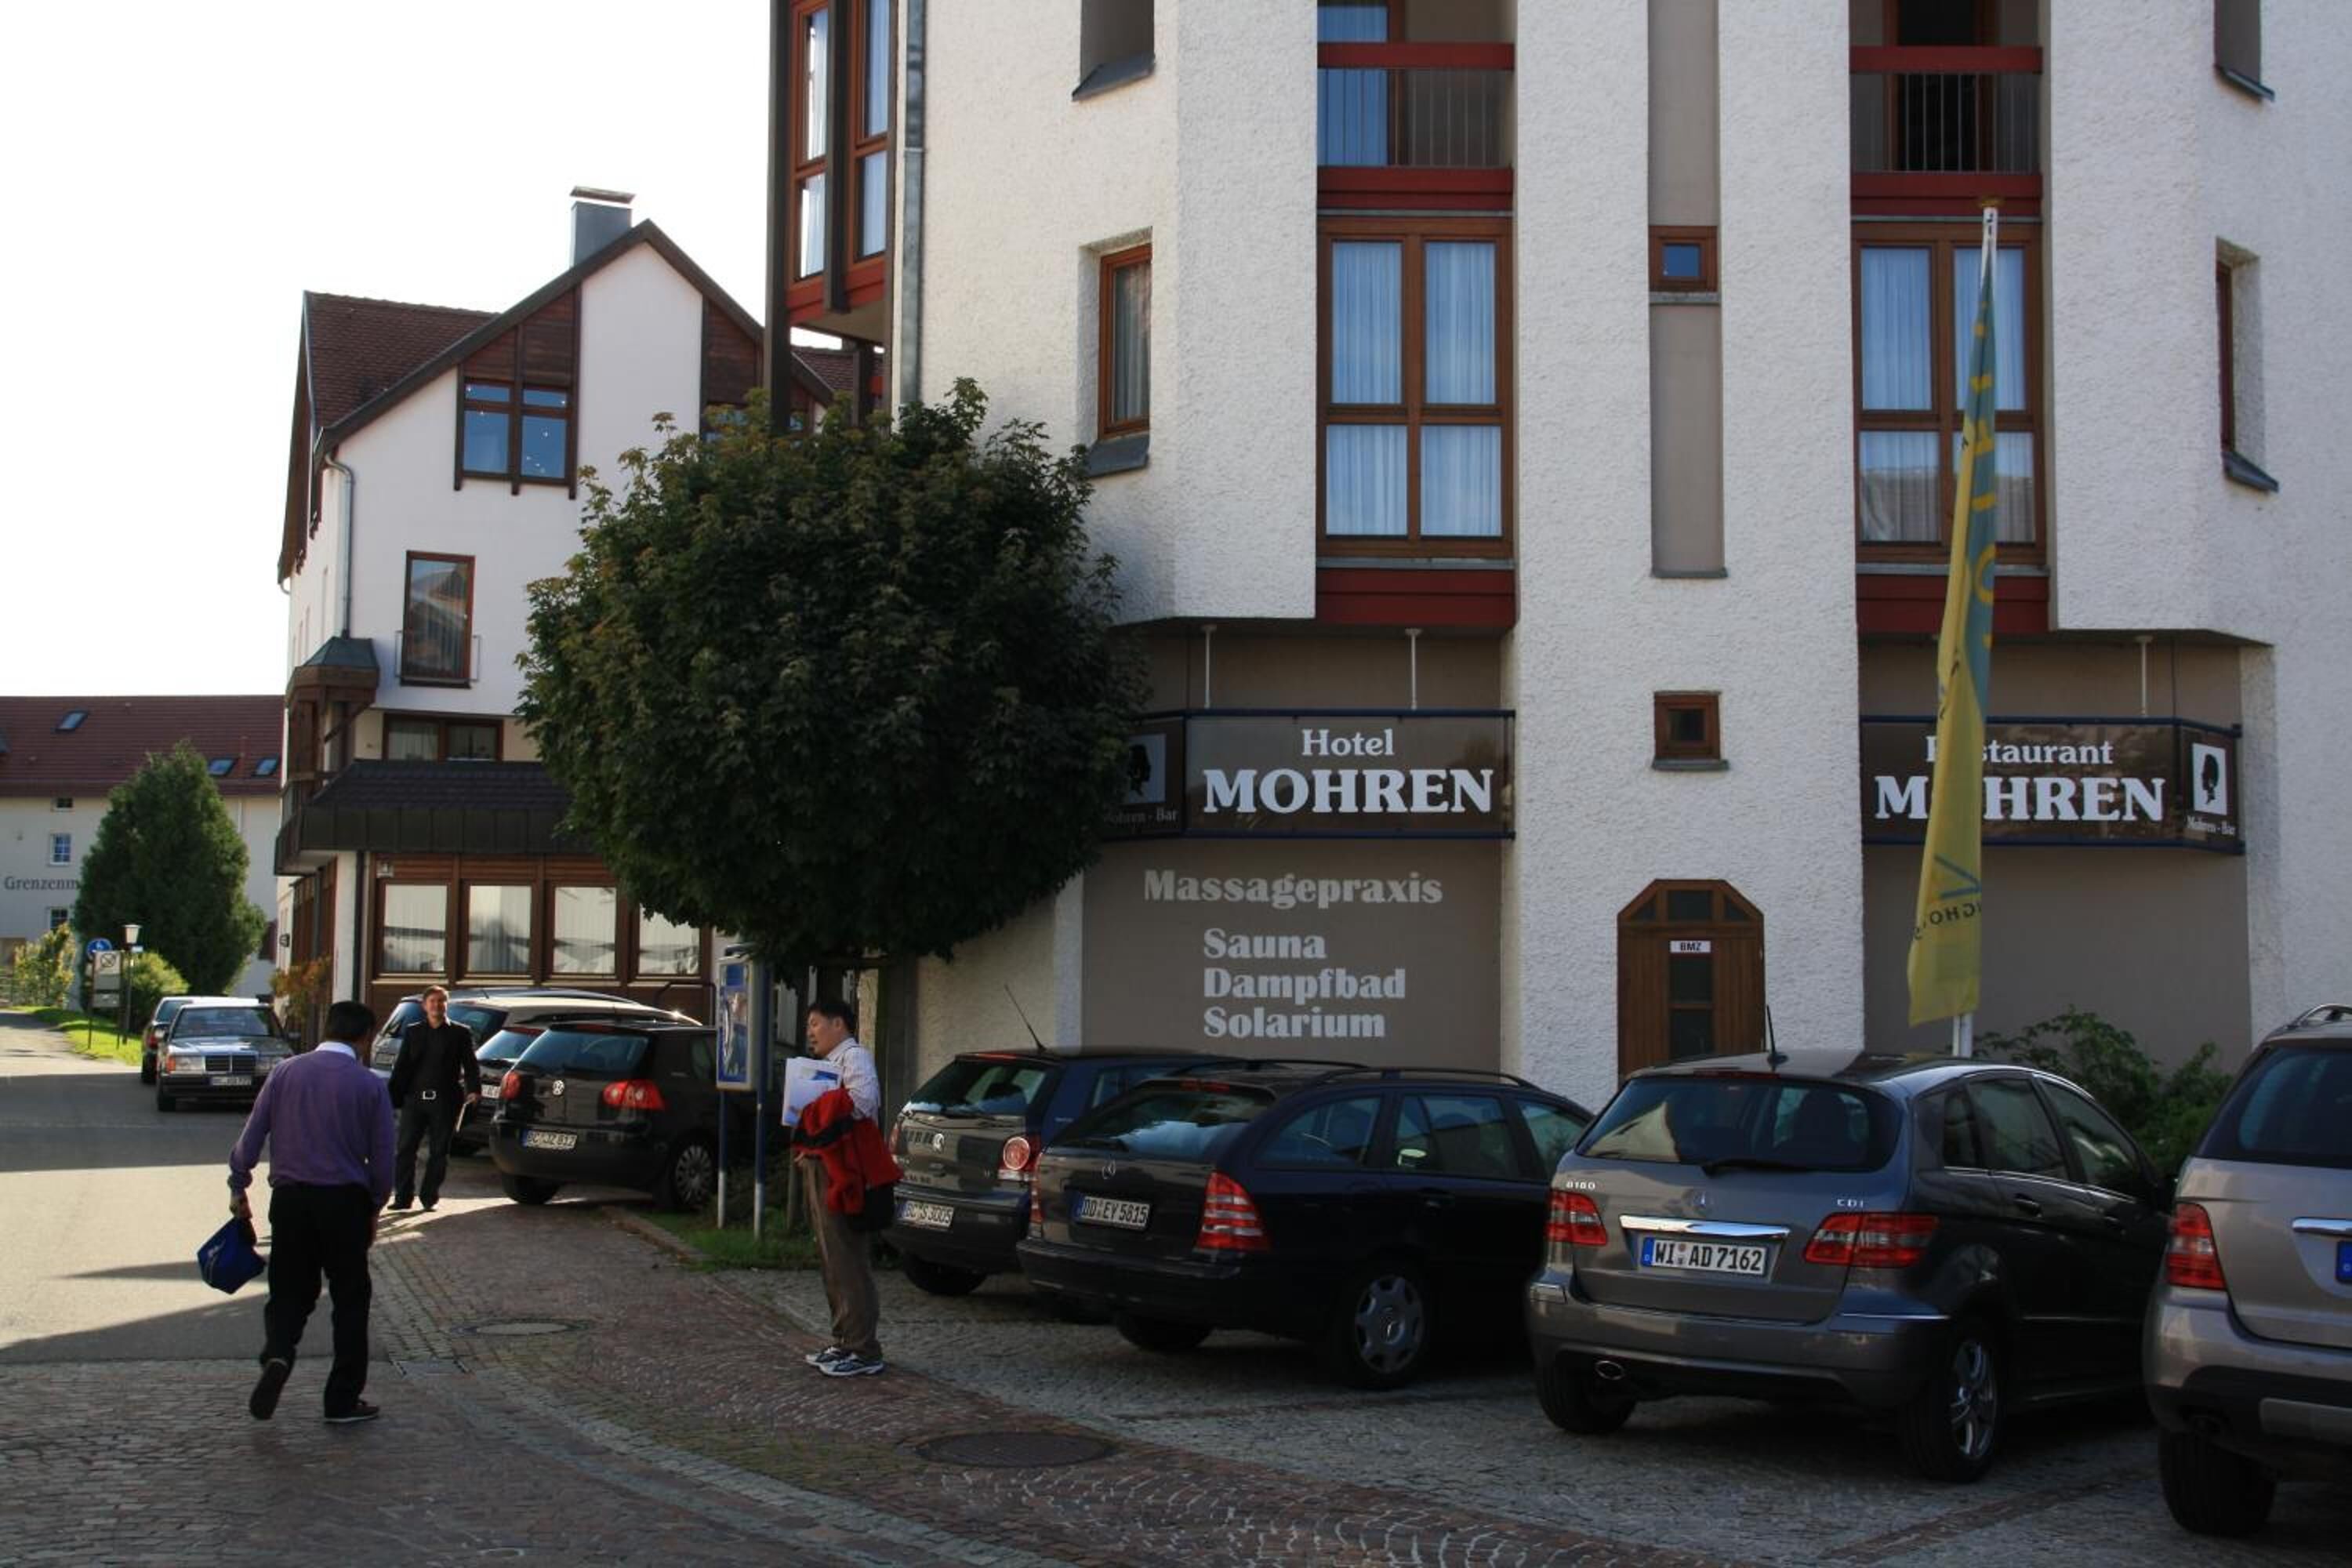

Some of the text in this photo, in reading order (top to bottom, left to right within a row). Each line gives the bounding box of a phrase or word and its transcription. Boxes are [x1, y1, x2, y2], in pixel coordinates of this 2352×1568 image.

[1301, 729, 1395, 757] Hotel
[1203, 769, 1494, 814] MOHREN
[1875, 775, 2165, 821] MHREN
[1156, 807, 1178, 822] Bar
[1144, 869, 1443, 909] Massagepraxis
[1203, 927, 1327, 959] Sauna
[1203, 967, 1406, 1005] Dampfbad
[1203, 1006, 1385, 1038] Solarium
[1837, 1198, 1864, 1208] CDI
[1656, 1242, 1675, 1264] WI
[1689, 1244, 1712, 1268] AD
[1717, 1247, 1762, 1272] 7162
